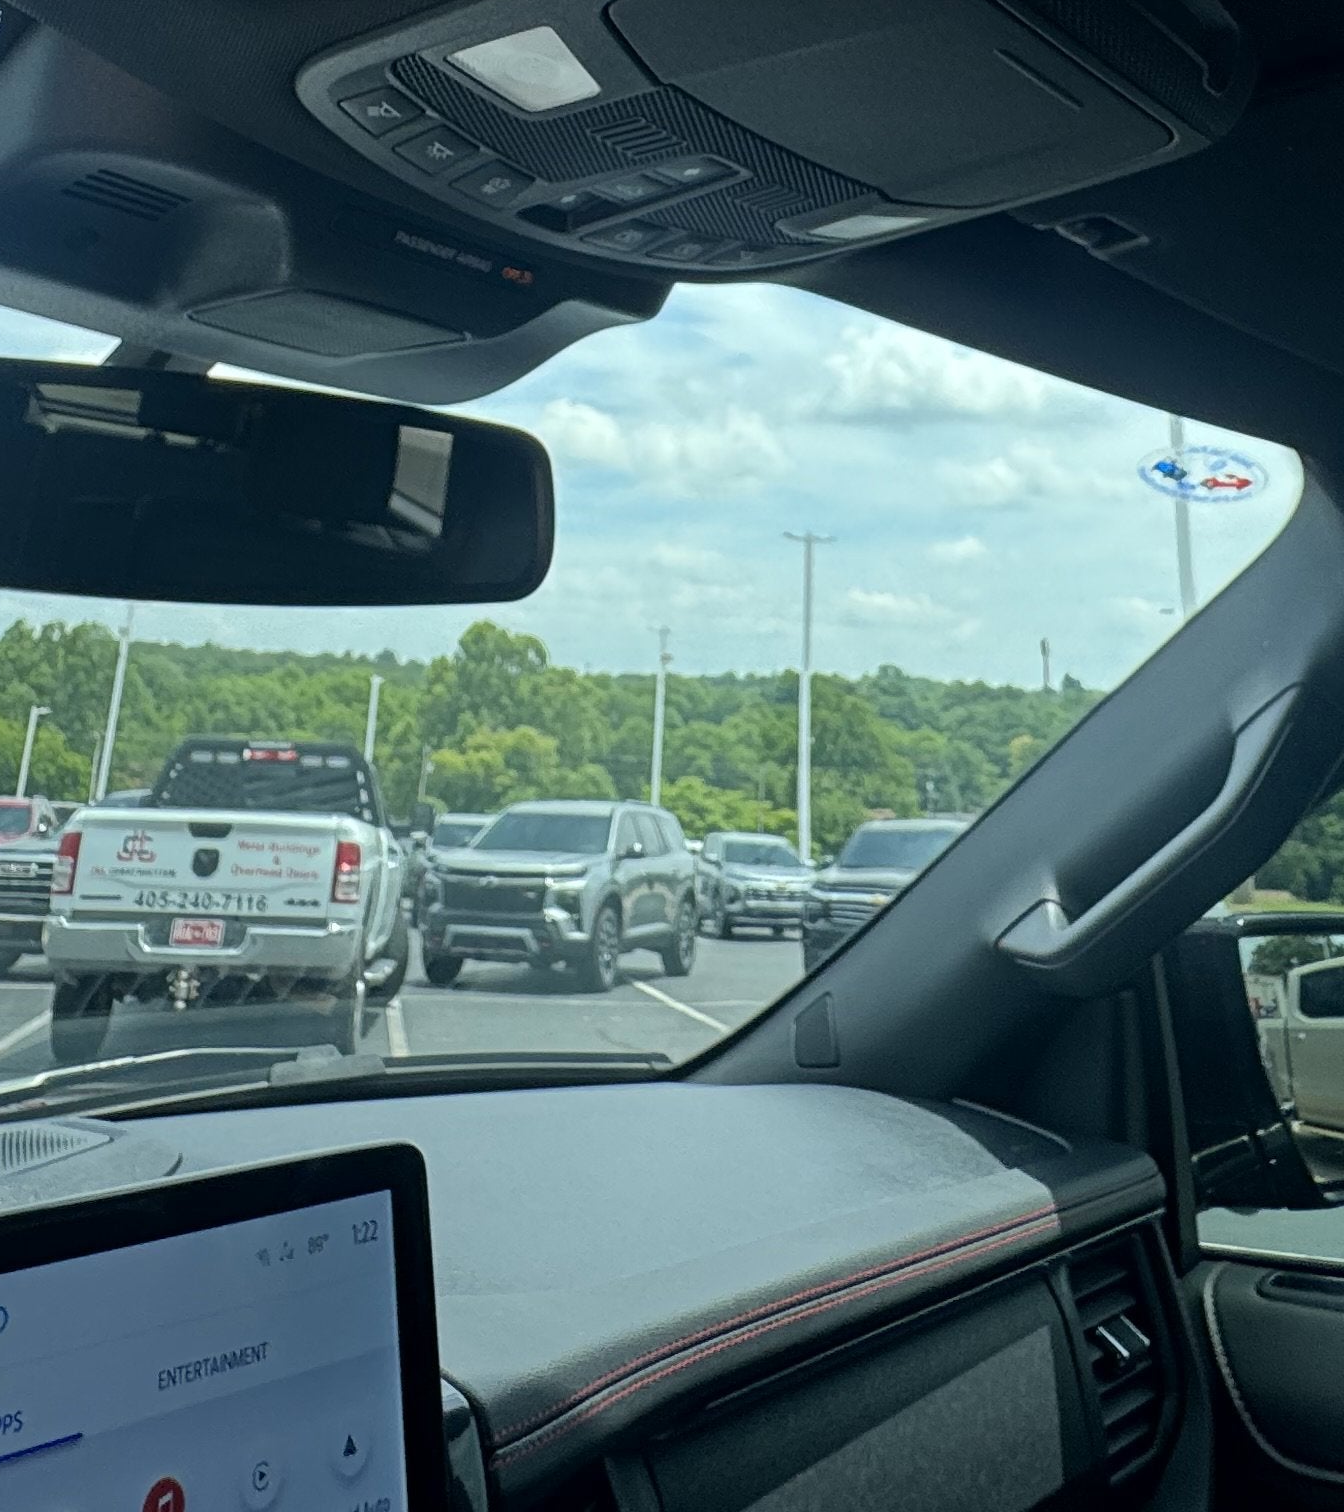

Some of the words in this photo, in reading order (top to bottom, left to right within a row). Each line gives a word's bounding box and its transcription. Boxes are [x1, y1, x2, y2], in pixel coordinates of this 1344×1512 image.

[133, 890, 269, 912] 405-240-7116
[352, 1219, 379, 1245] 1:22
[157, 1341, 271, 1390] ENTERTAINMENT
